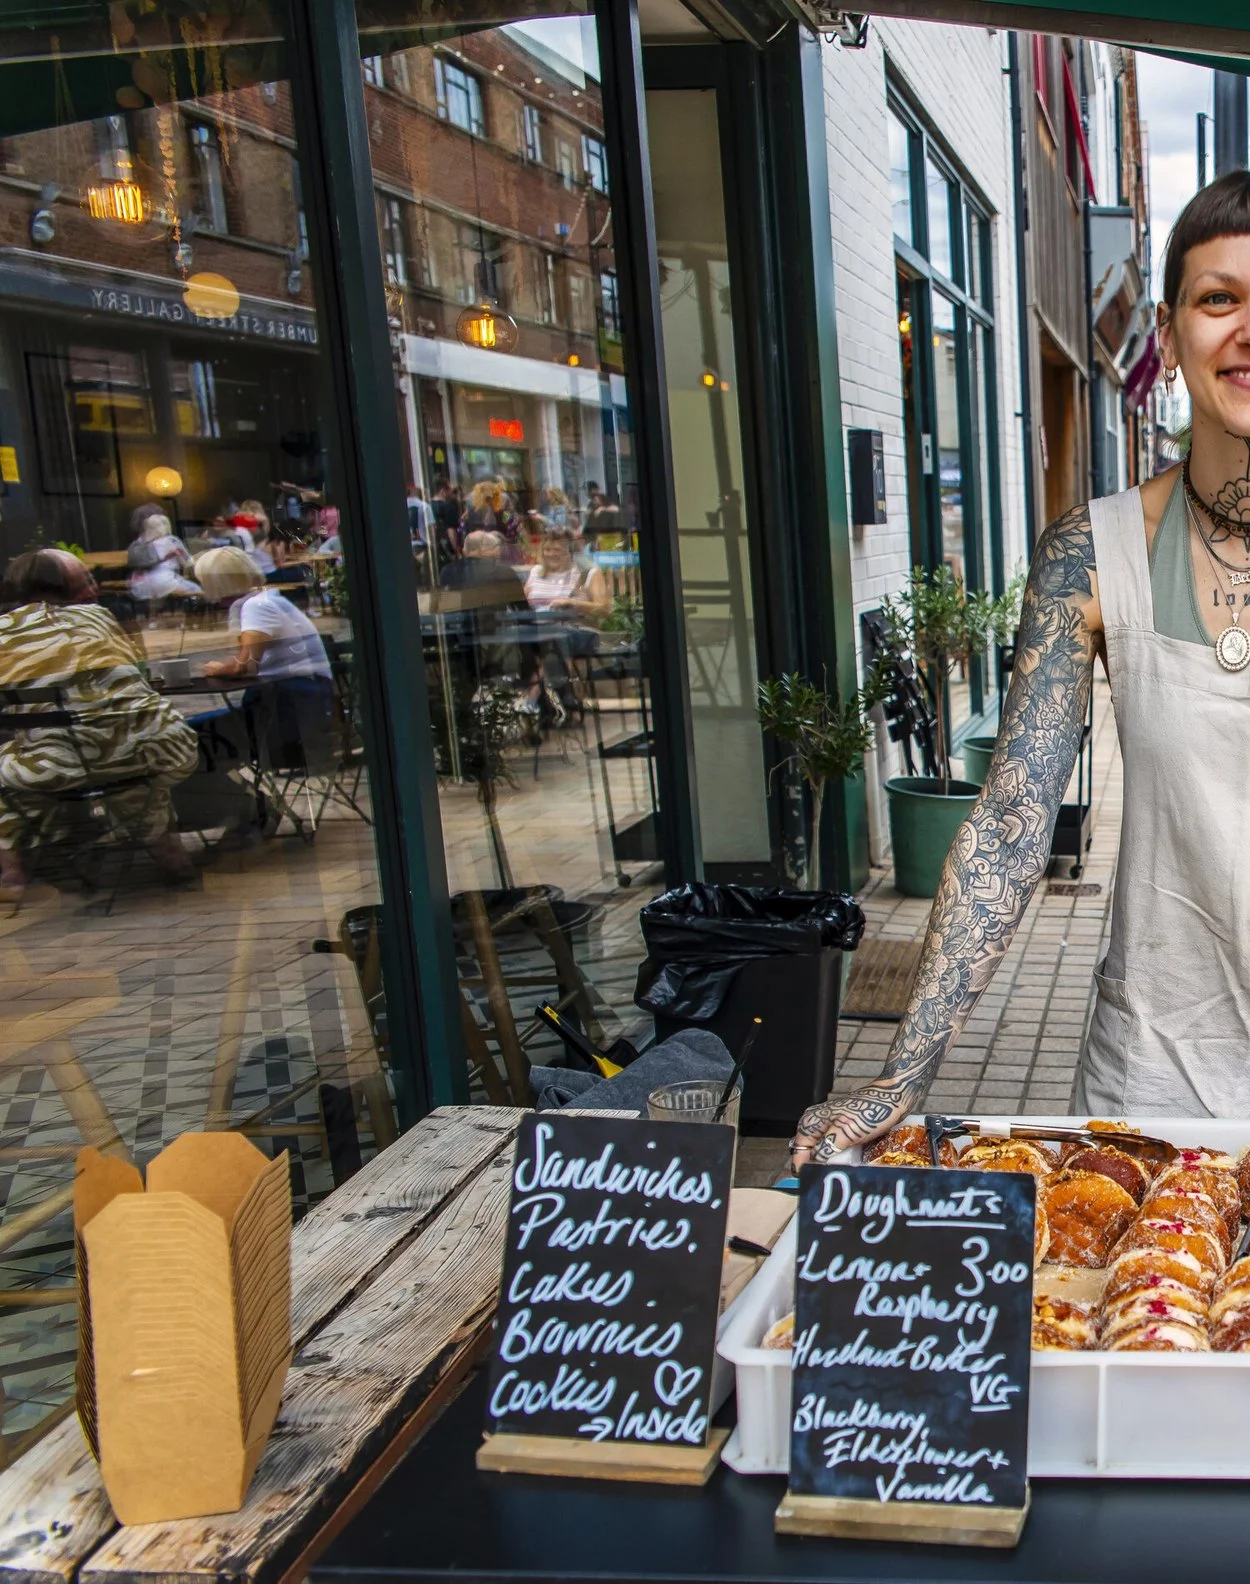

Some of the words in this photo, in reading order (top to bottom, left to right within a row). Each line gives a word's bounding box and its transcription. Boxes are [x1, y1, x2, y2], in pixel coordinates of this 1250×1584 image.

[813, 1171, 1004, 1244] Doughnuts
[508, 1261, 635, 1307] Cakes
[954, 1235, 1030, 1298] 3.00
[853, 1281, 999, 1350] Raspberry
[792, 1322, 917, 1371] Hazelnut
[489, 1360, 618, 1418] Cookies
[969, 1373, 1021, 1404] VG
[615, 1390, 709, 1444] Inside
[875, 1467, 995, 1503] Vanilla
